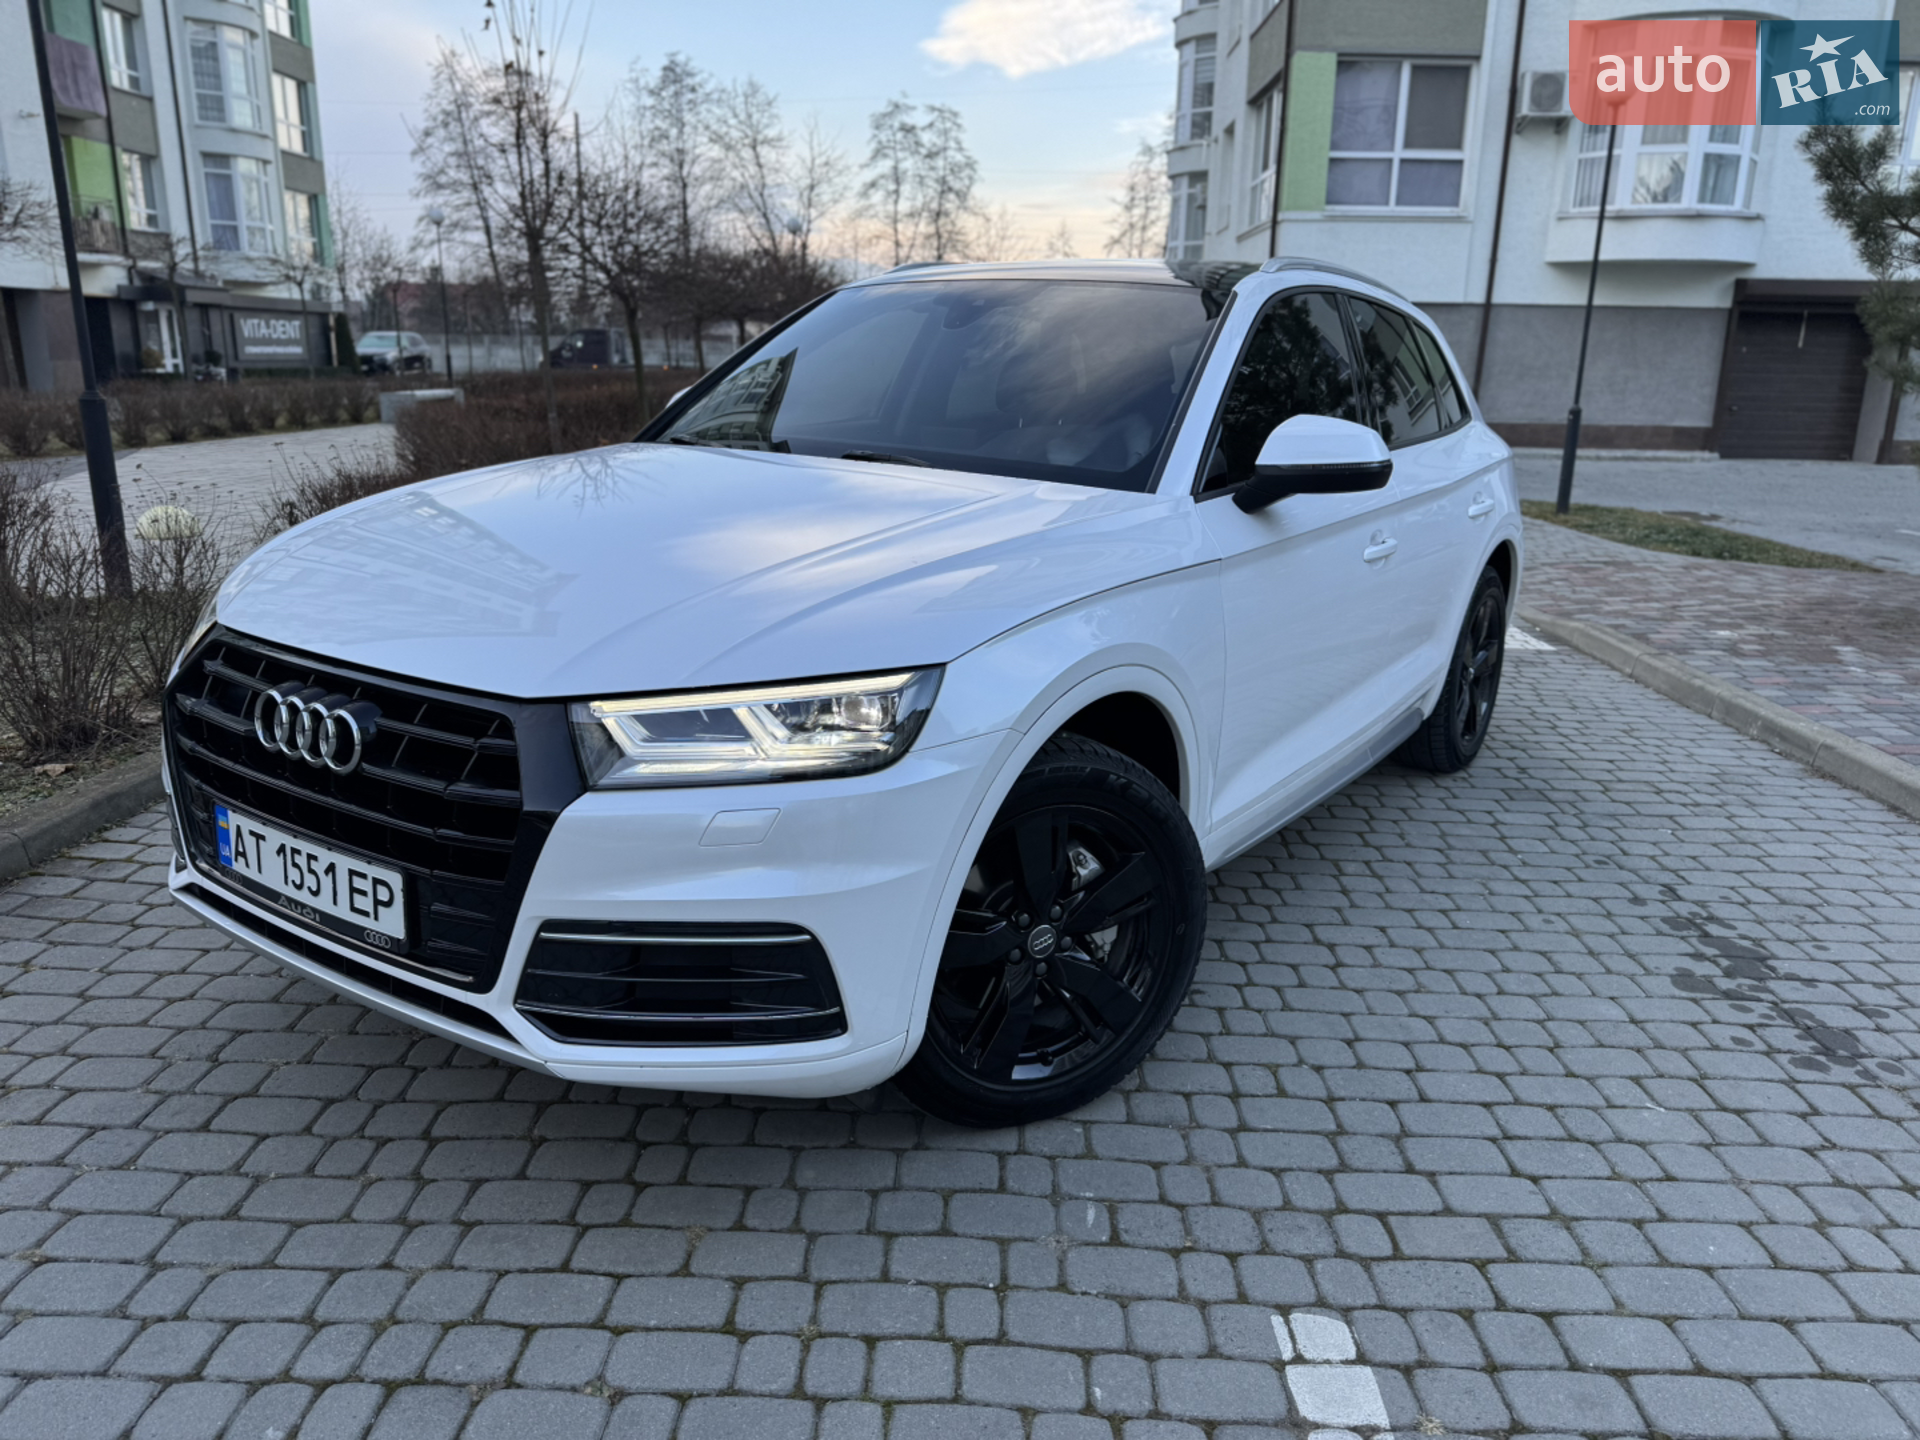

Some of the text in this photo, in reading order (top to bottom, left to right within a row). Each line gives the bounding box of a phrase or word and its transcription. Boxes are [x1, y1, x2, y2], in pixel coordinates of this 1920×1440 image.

[240, 318, 301, 339] VITA-DENT
[234, 823, 395, 922] AT 1551 EP
[277, 895, 320, 922] Audi
